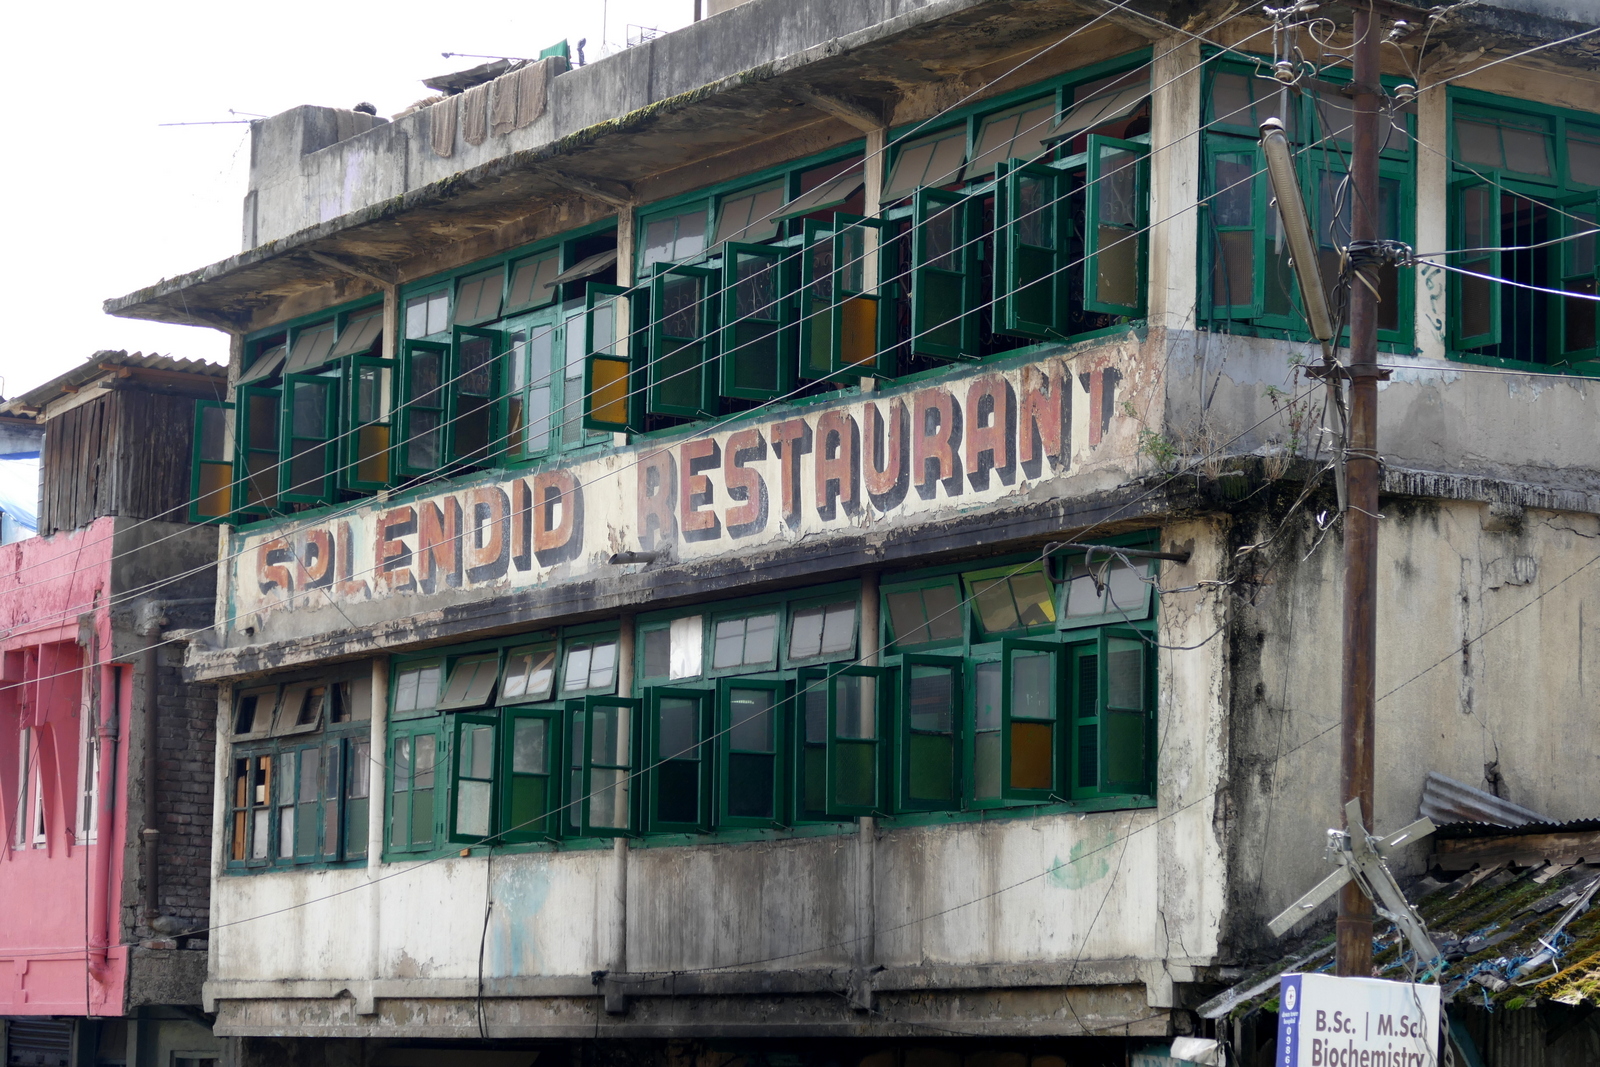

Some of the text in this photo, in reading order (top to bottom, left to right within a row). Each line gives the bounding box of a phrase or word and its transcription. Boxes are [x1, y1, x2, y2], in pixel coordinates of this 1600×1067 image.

[256, 359, 1123, 602] SPLENDID RESTAURANT
[1315, 1009, 1356, 1035] B.Sc.
[1311, 1038, 1425, 1067] Biochemistry
